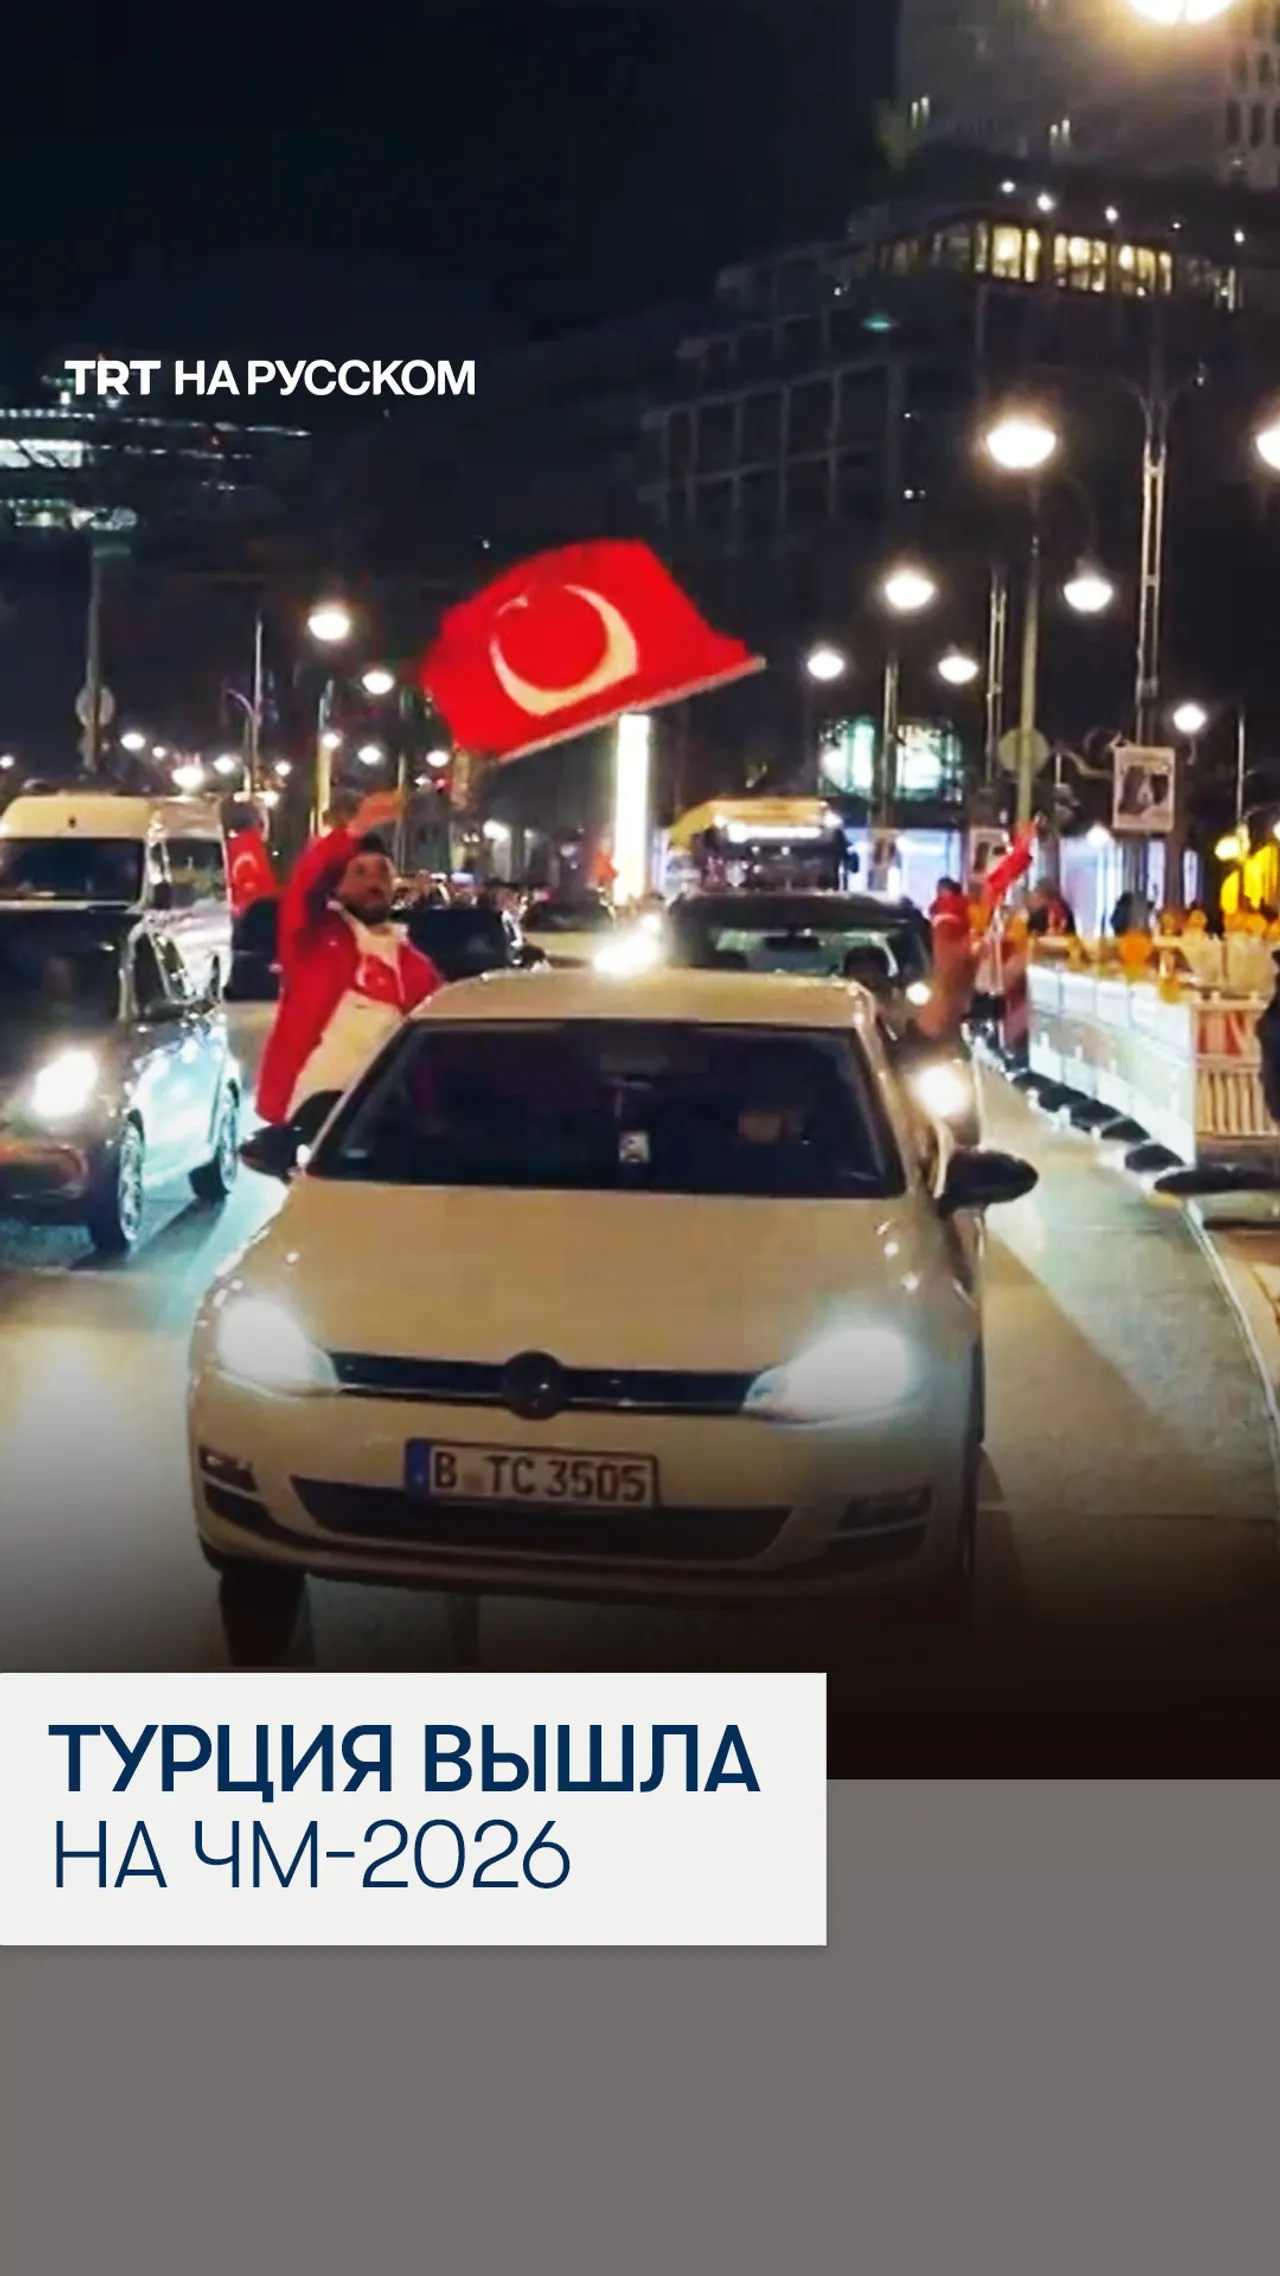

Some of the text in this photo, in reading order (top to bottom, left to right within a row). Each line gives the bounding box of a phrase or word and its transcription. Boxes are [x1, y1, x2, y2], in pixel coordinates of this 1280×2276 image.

[433, 1451, 648, 1502] B TC 3505
